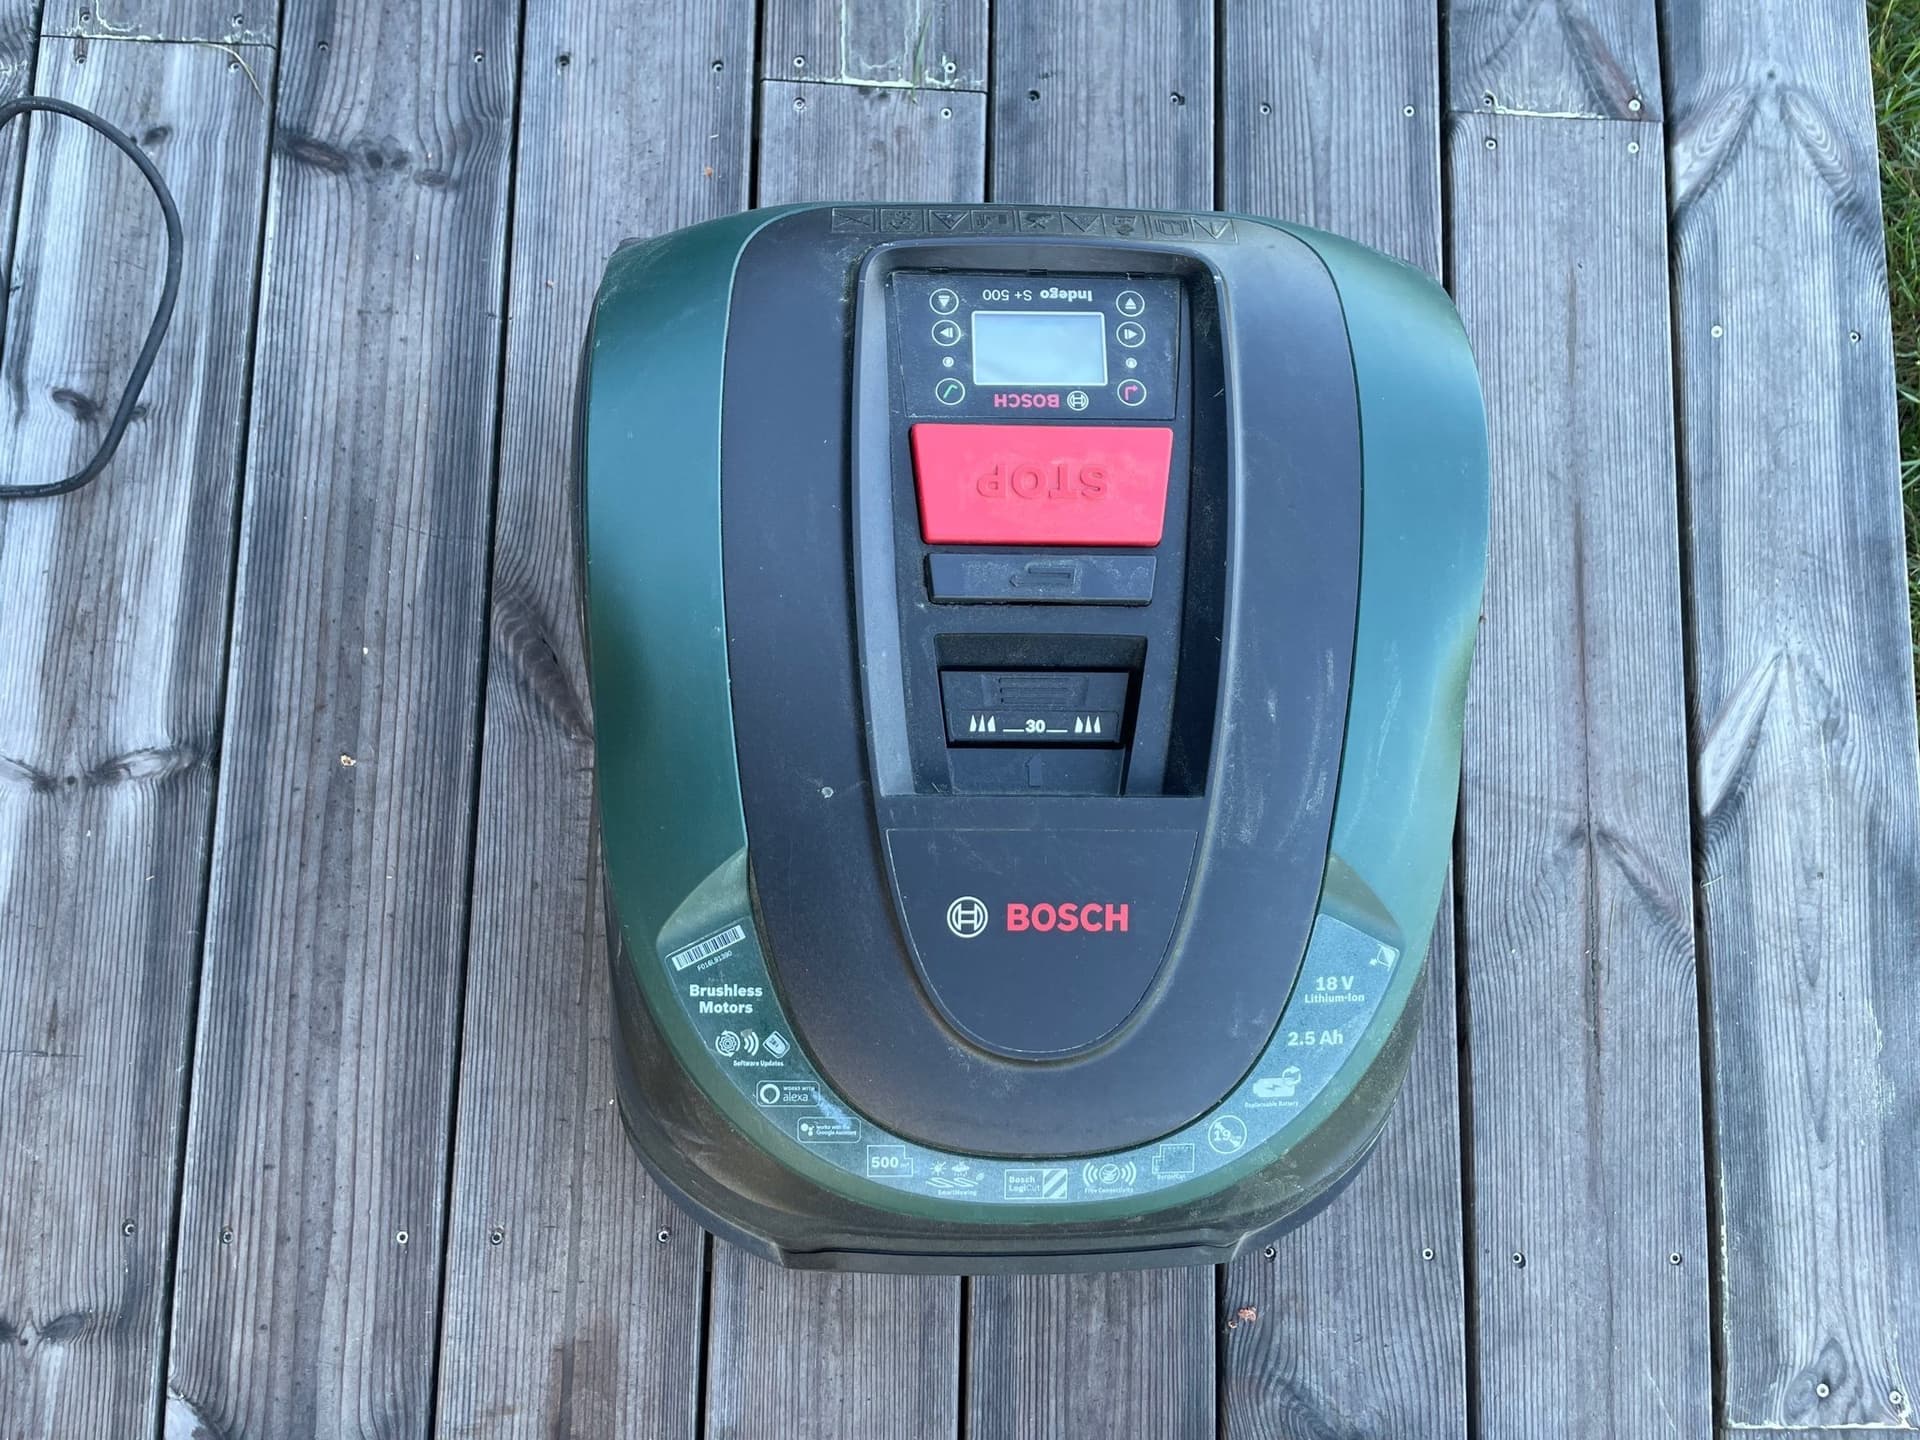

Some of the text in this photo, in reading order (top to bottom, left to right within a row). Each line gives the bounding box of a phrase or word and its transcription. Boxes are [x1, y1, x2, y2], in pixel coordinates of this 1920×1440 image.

[982, 287, 1093, 301] Indego S+ 500
[993, 393, 1060, 408] BOSCH
[976, 462, 1108, 499] STOP
[1025, 719, 1046, 733] 30
[1006, 902, 1129, 932] BOSCH
[1315, 975, 1355, 991] 18 V
[689, 984, 763, 998] Brushless
[1304, 993, 1365, 1004] Lithium-Ion
[699, 1001, 753, 1014] Motors
[1287, 1029, 1344, 1047] 2.5 Ah
[760, 1060, 784, 1068] Updates
[782, 1091, 809, 1102] alexa
[1214, 1129, 1231, 1141] 19
[871, 1156, 899, 1169] 500
[1009, 1175, 1036, 1184] Bosch
[1008, 1184, 1041, 1193] LogiCut
